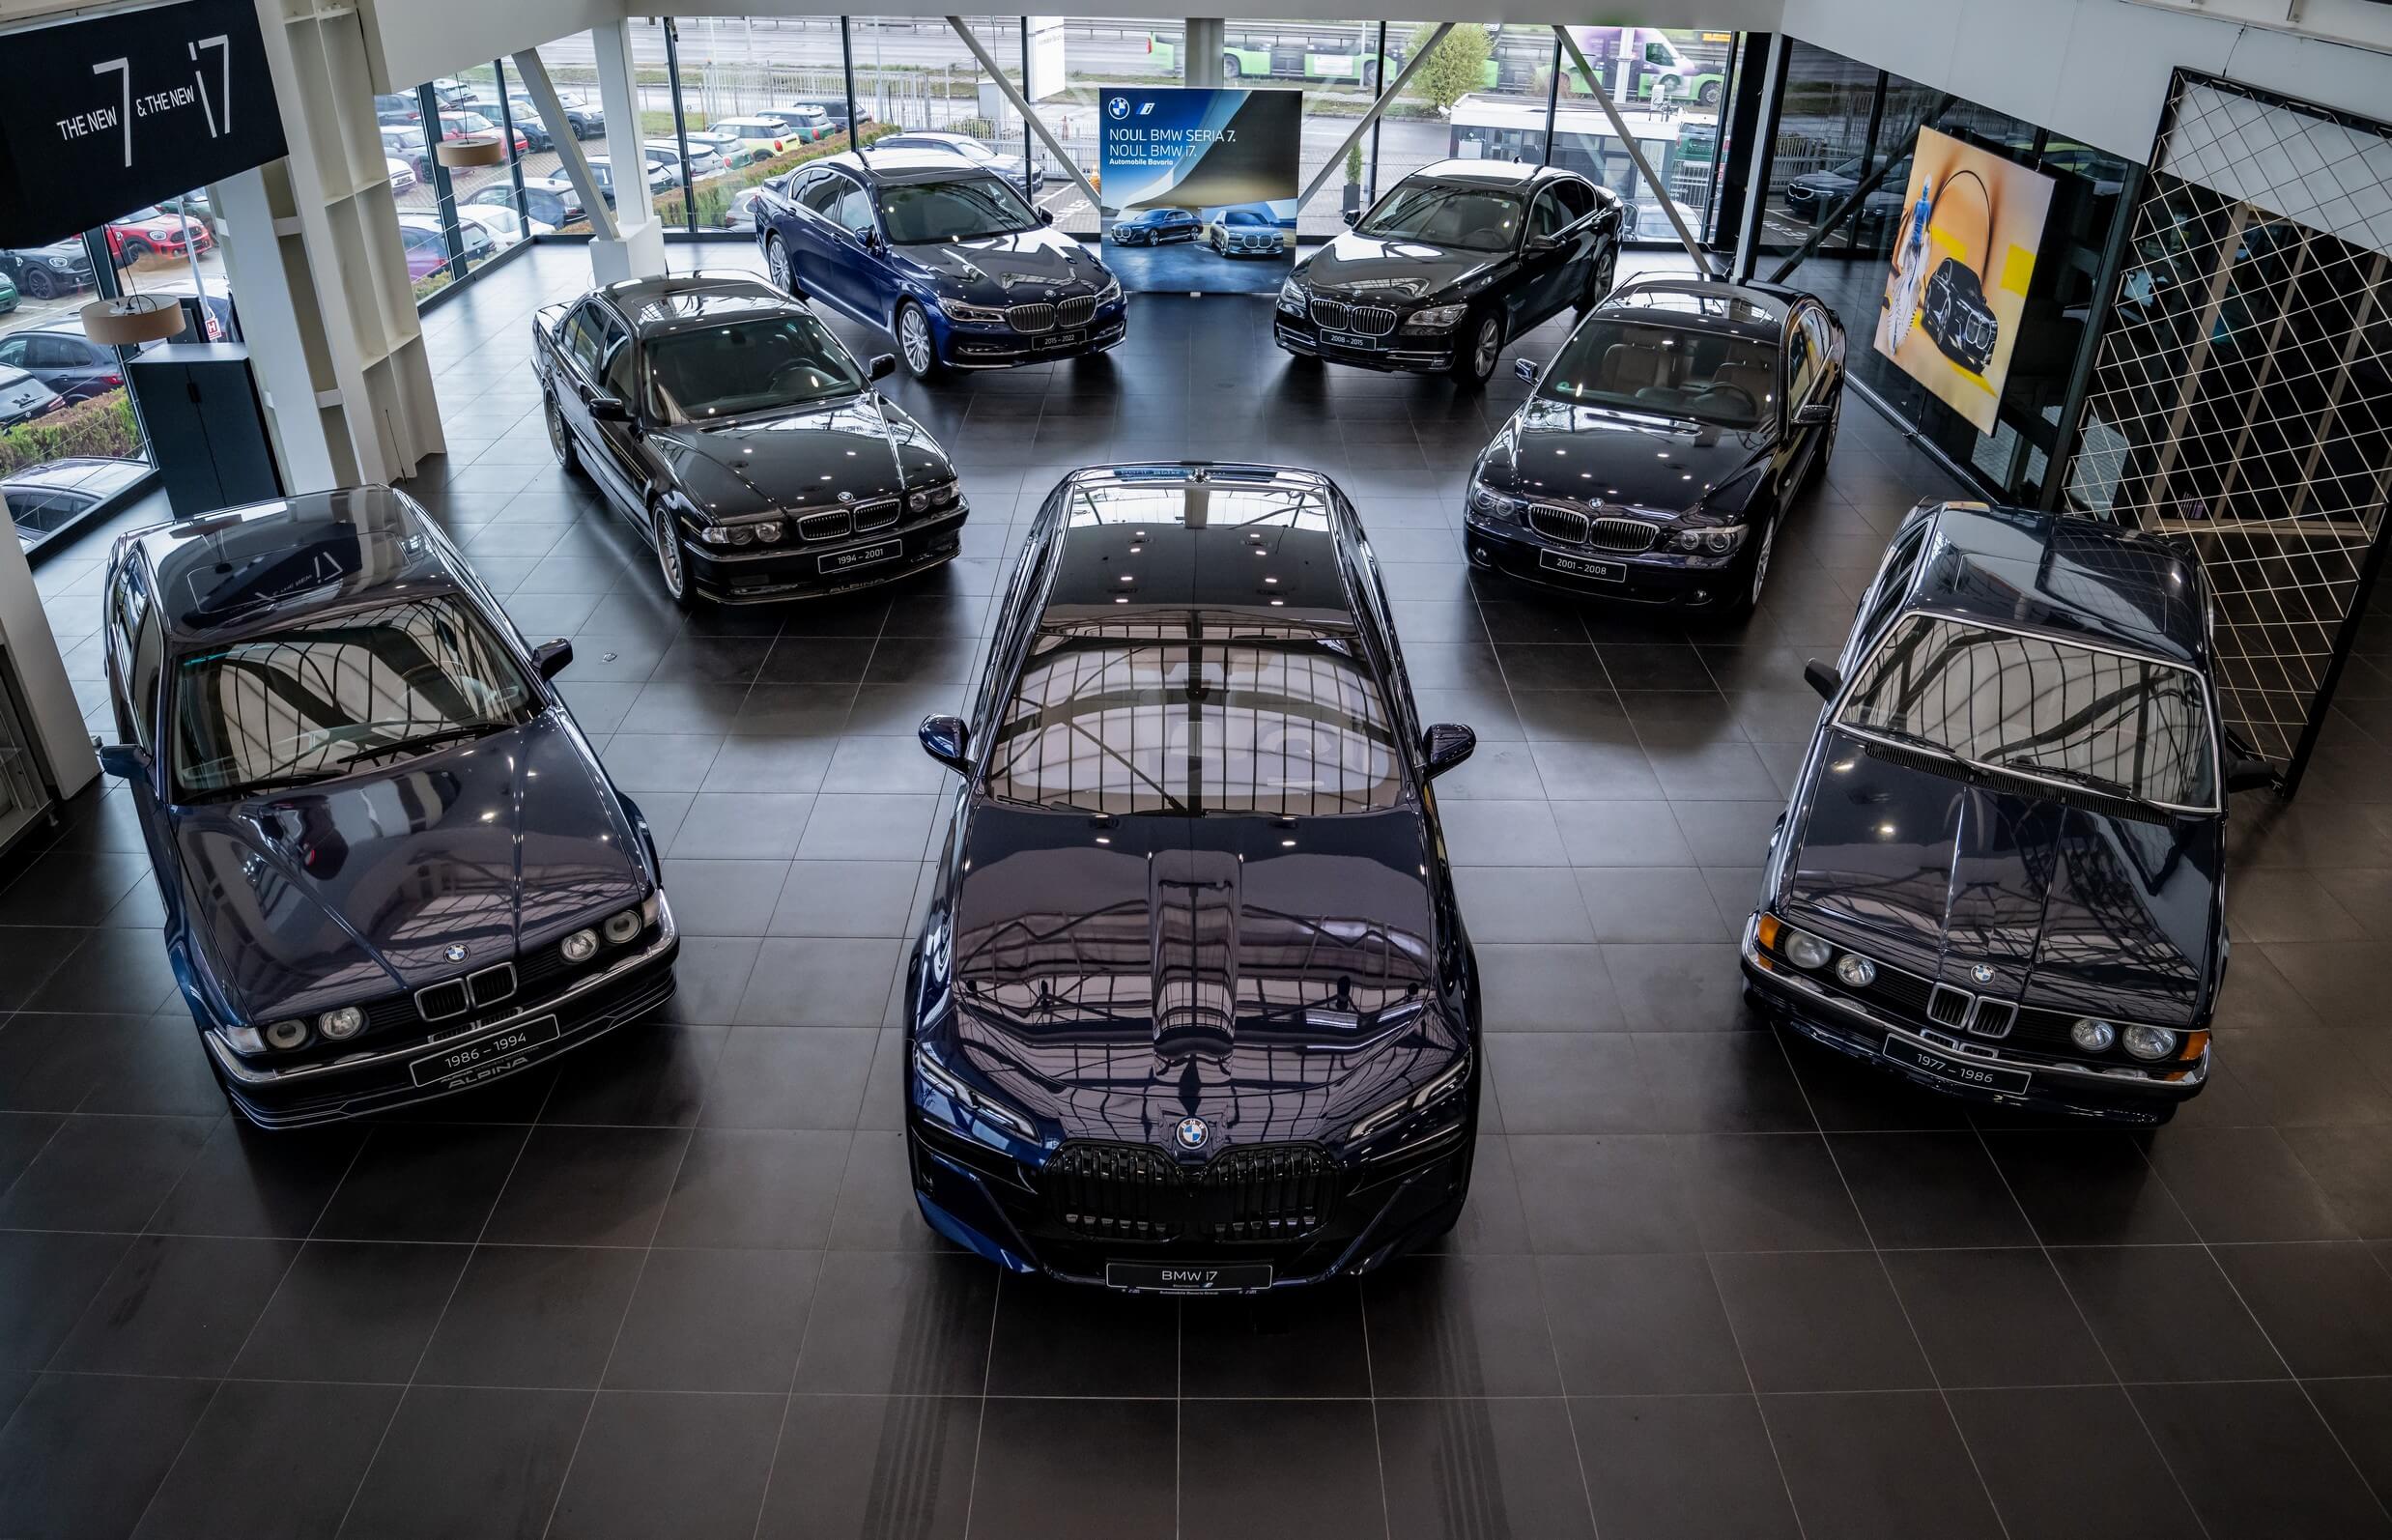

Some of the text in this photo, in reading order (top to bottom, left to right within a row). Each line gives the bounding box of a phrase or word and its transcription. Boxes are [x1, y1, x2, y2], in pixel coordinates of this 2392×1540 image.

[56, 34, 230, 167] THE NEW 7 & THE NEW i7
[1109, 128, 1237, 142] NOUL BMW SERIA 7.
[1109, 144, 1197, 157] NOUL BMW i7.
[1330, 334, 1346, 343] 2008
[838, 554, 857, 564] 1994
[865, 549, 884, 559] 2001
[1556, 558, 1576, 569] 2001
[1584, 564, 1607, 575] 2008
[444, 1048, 479, 1068] 1986
[493, 1032, 527, 1052] 1994
[448, 1056, 528, 1089] ALPINA
[1917, 1053, 1947, 1070] 1977
[1959, 1068, 1994, 1083] 1986
[1162, 1270, 1218, 1281] BMW i7
